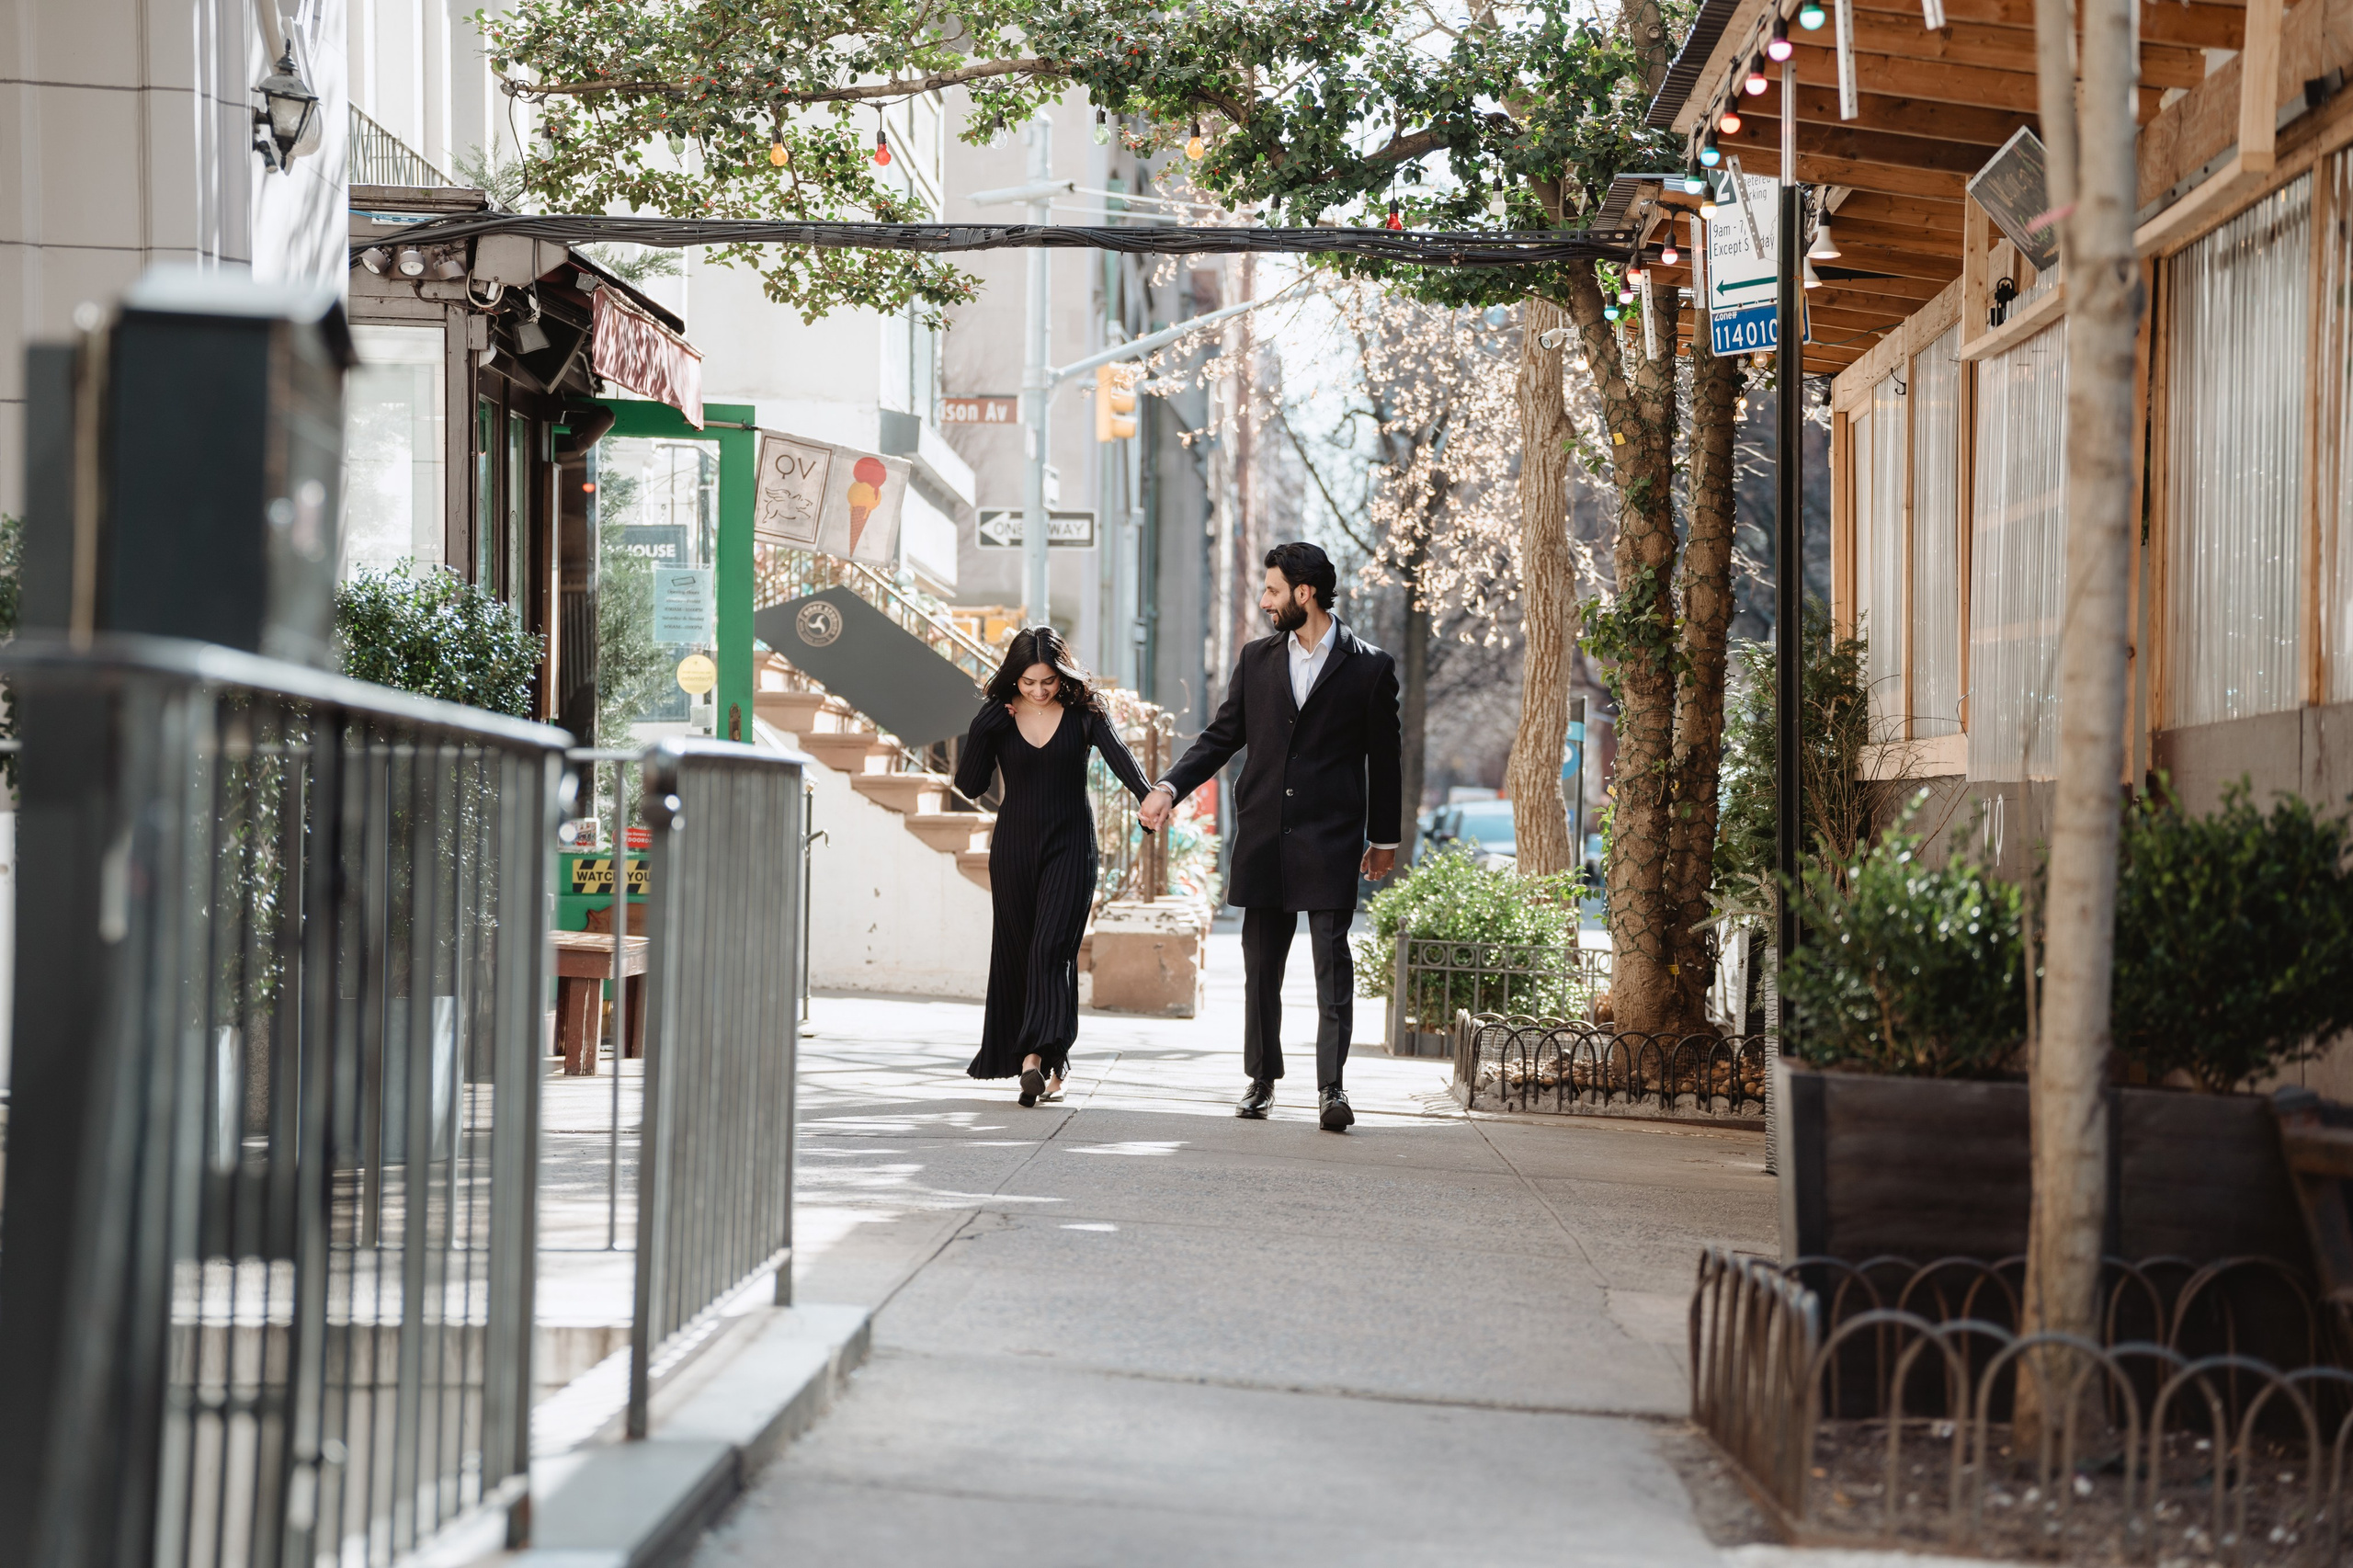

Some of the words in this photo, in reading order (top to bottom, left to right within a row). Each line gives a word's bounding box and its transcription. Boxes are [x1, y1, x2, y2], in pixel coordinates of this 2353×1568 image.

[1715, 169, 1730, 202] 2
[1713, 223, 1731, 238] 9am
[1714, 238, 1742, 256] Except
[1745, 234, 1775, 252] Sday
[984, 401, 1008, 421] Av
[775, 454, 817, 481] QV
[994, 521, 1023, 536] ONE
[1047, 523, 1084, 536] WAY
